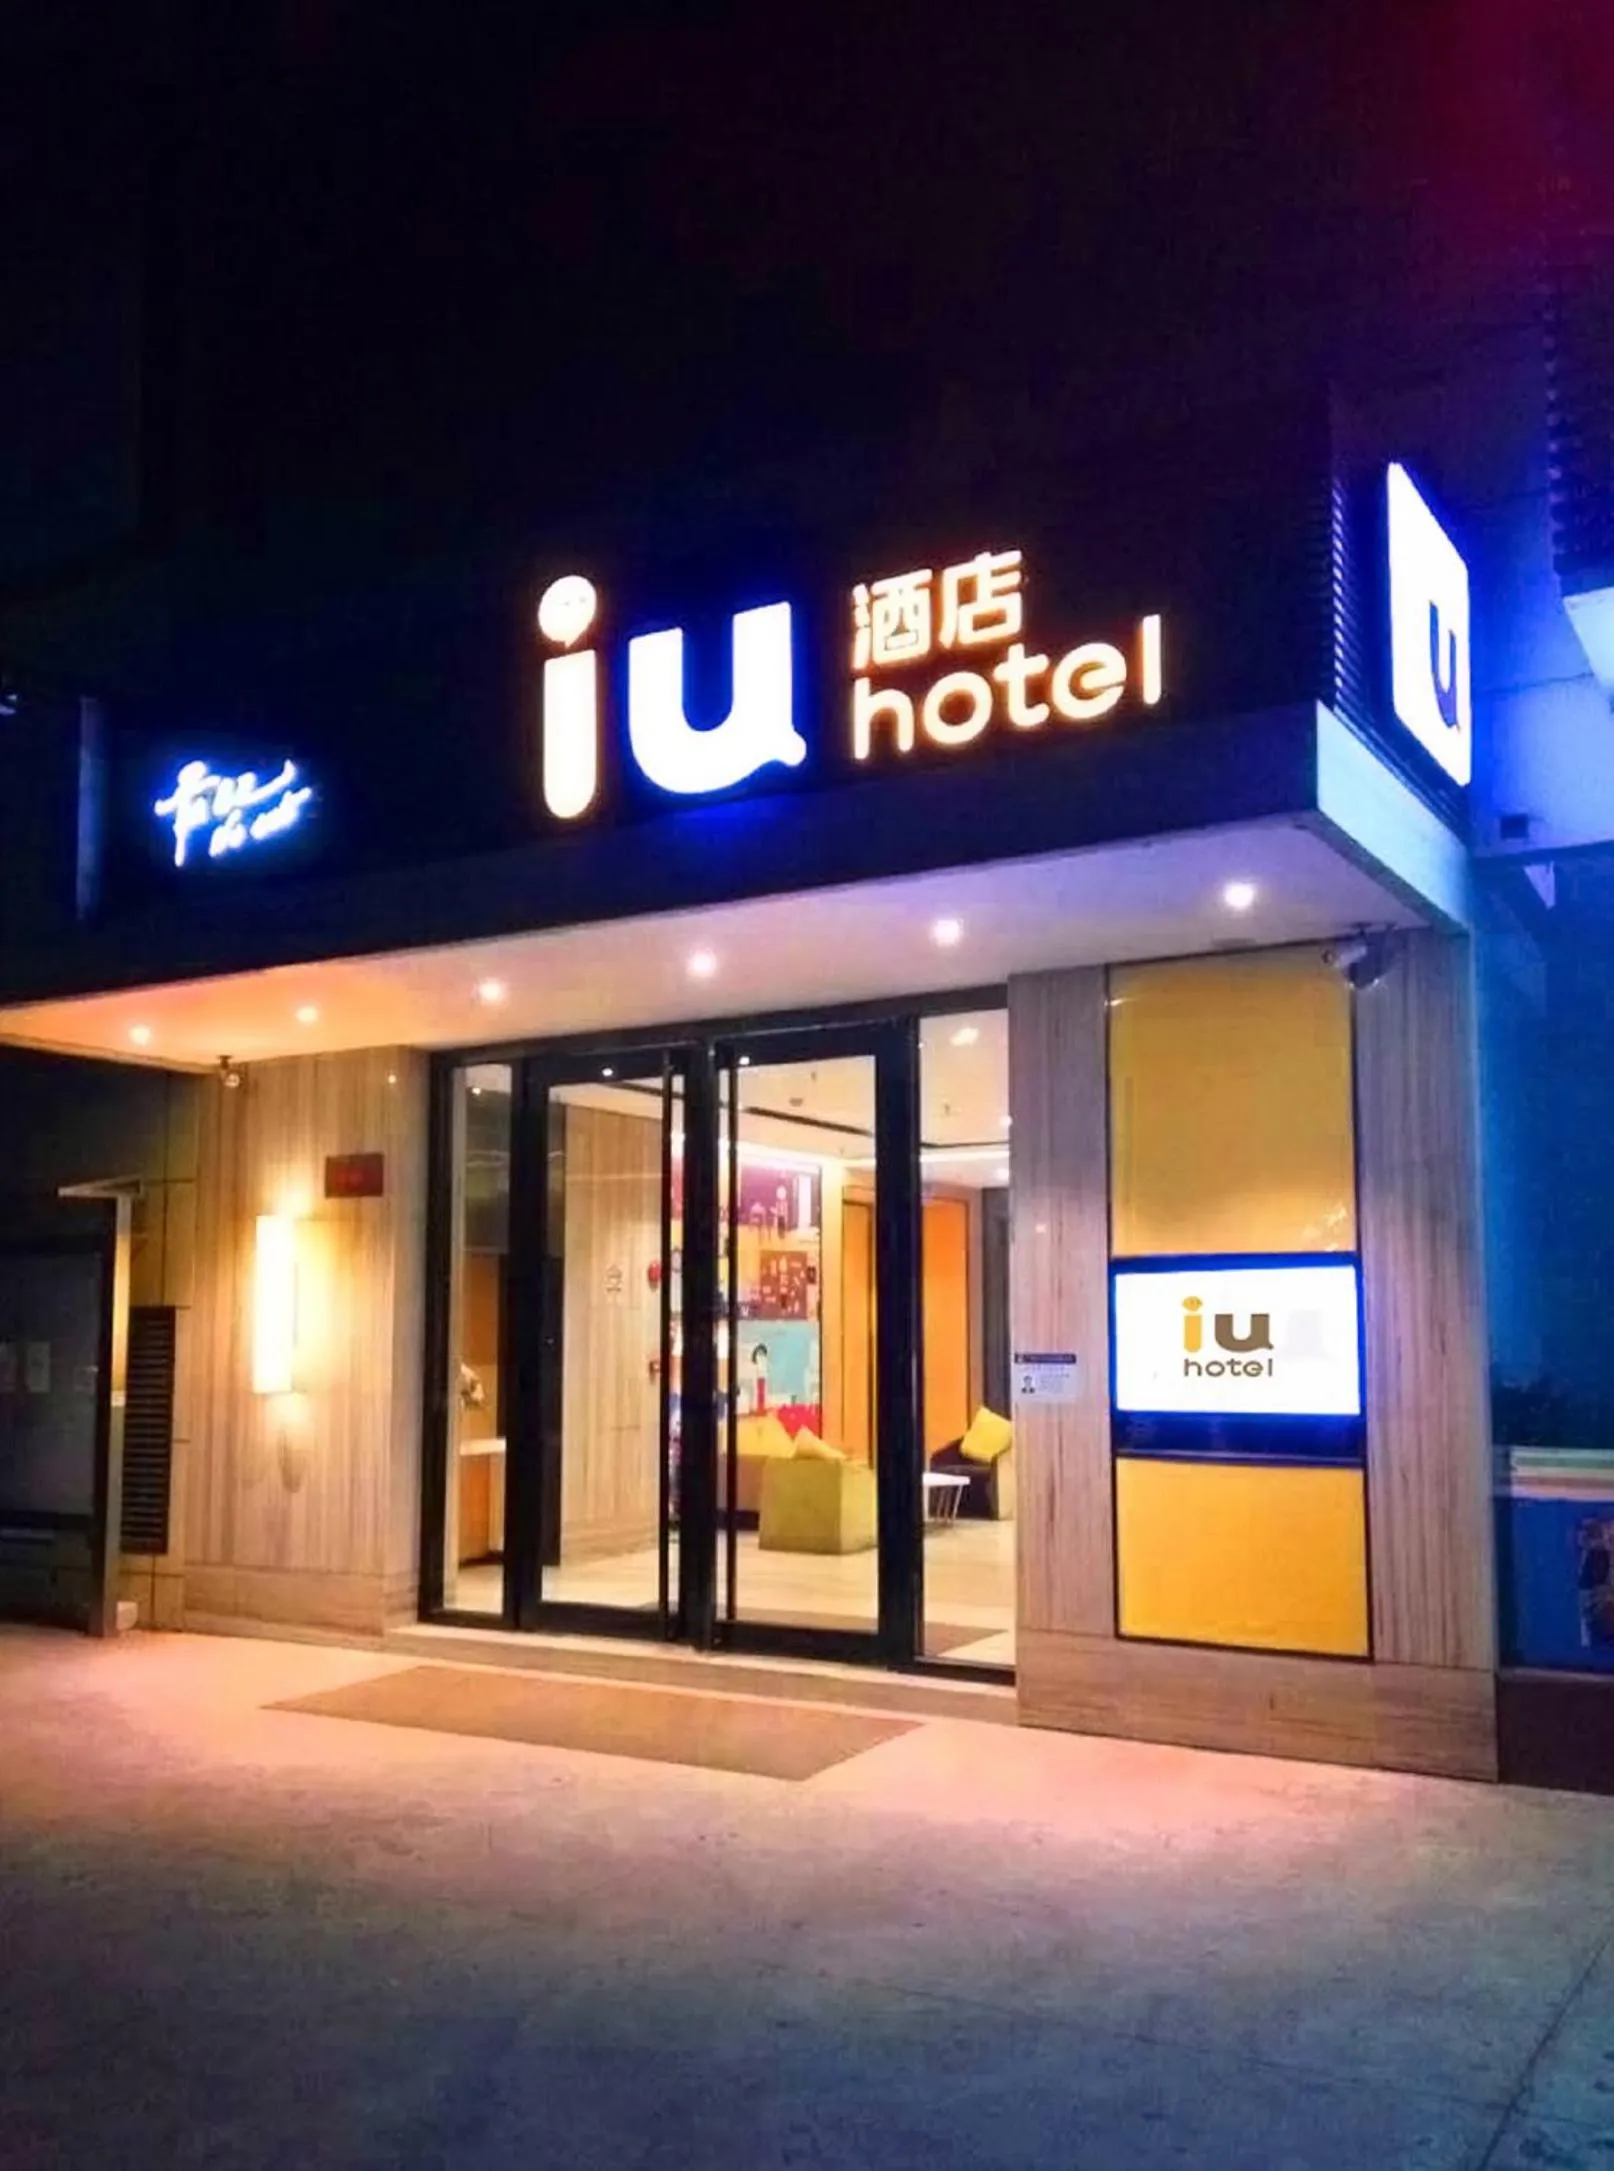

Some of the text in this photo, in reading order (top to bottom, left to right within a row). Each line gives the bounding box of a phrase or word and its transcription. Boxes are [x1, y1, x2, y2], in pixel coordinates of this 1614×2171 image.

[852, 551, 1022, 668] 酒店
[538, 575, 806, 818] iu
[852, 614, 1161, 760] hotel
[1182, 1296, 1275, 1353] iu
[1184, 1358, 1273, 1378] hotel
